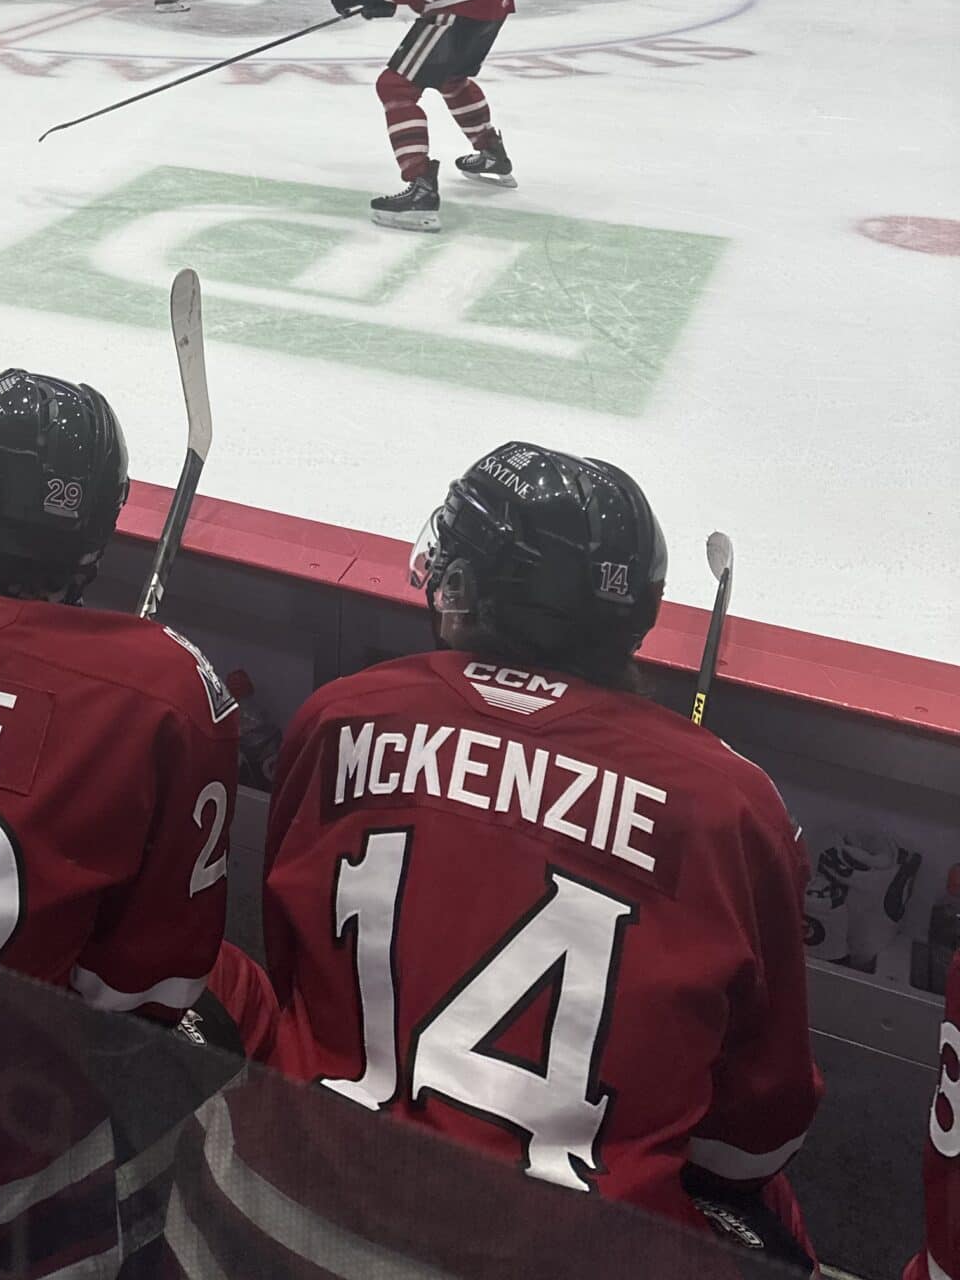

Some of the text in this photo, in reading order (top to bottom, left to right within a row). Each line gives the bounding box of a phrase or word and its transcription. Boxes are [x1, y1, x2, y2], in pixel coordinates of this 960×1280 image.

[44, 478, 83, 510] 29
[478, 456, 534, 501] SKYLINE
[600, 561, 628, 595] 14
[463, 661, 569, 698] CCM
[334, 721, 669, 873] McKENZIE
[321, 831, 632, 1192] 14
